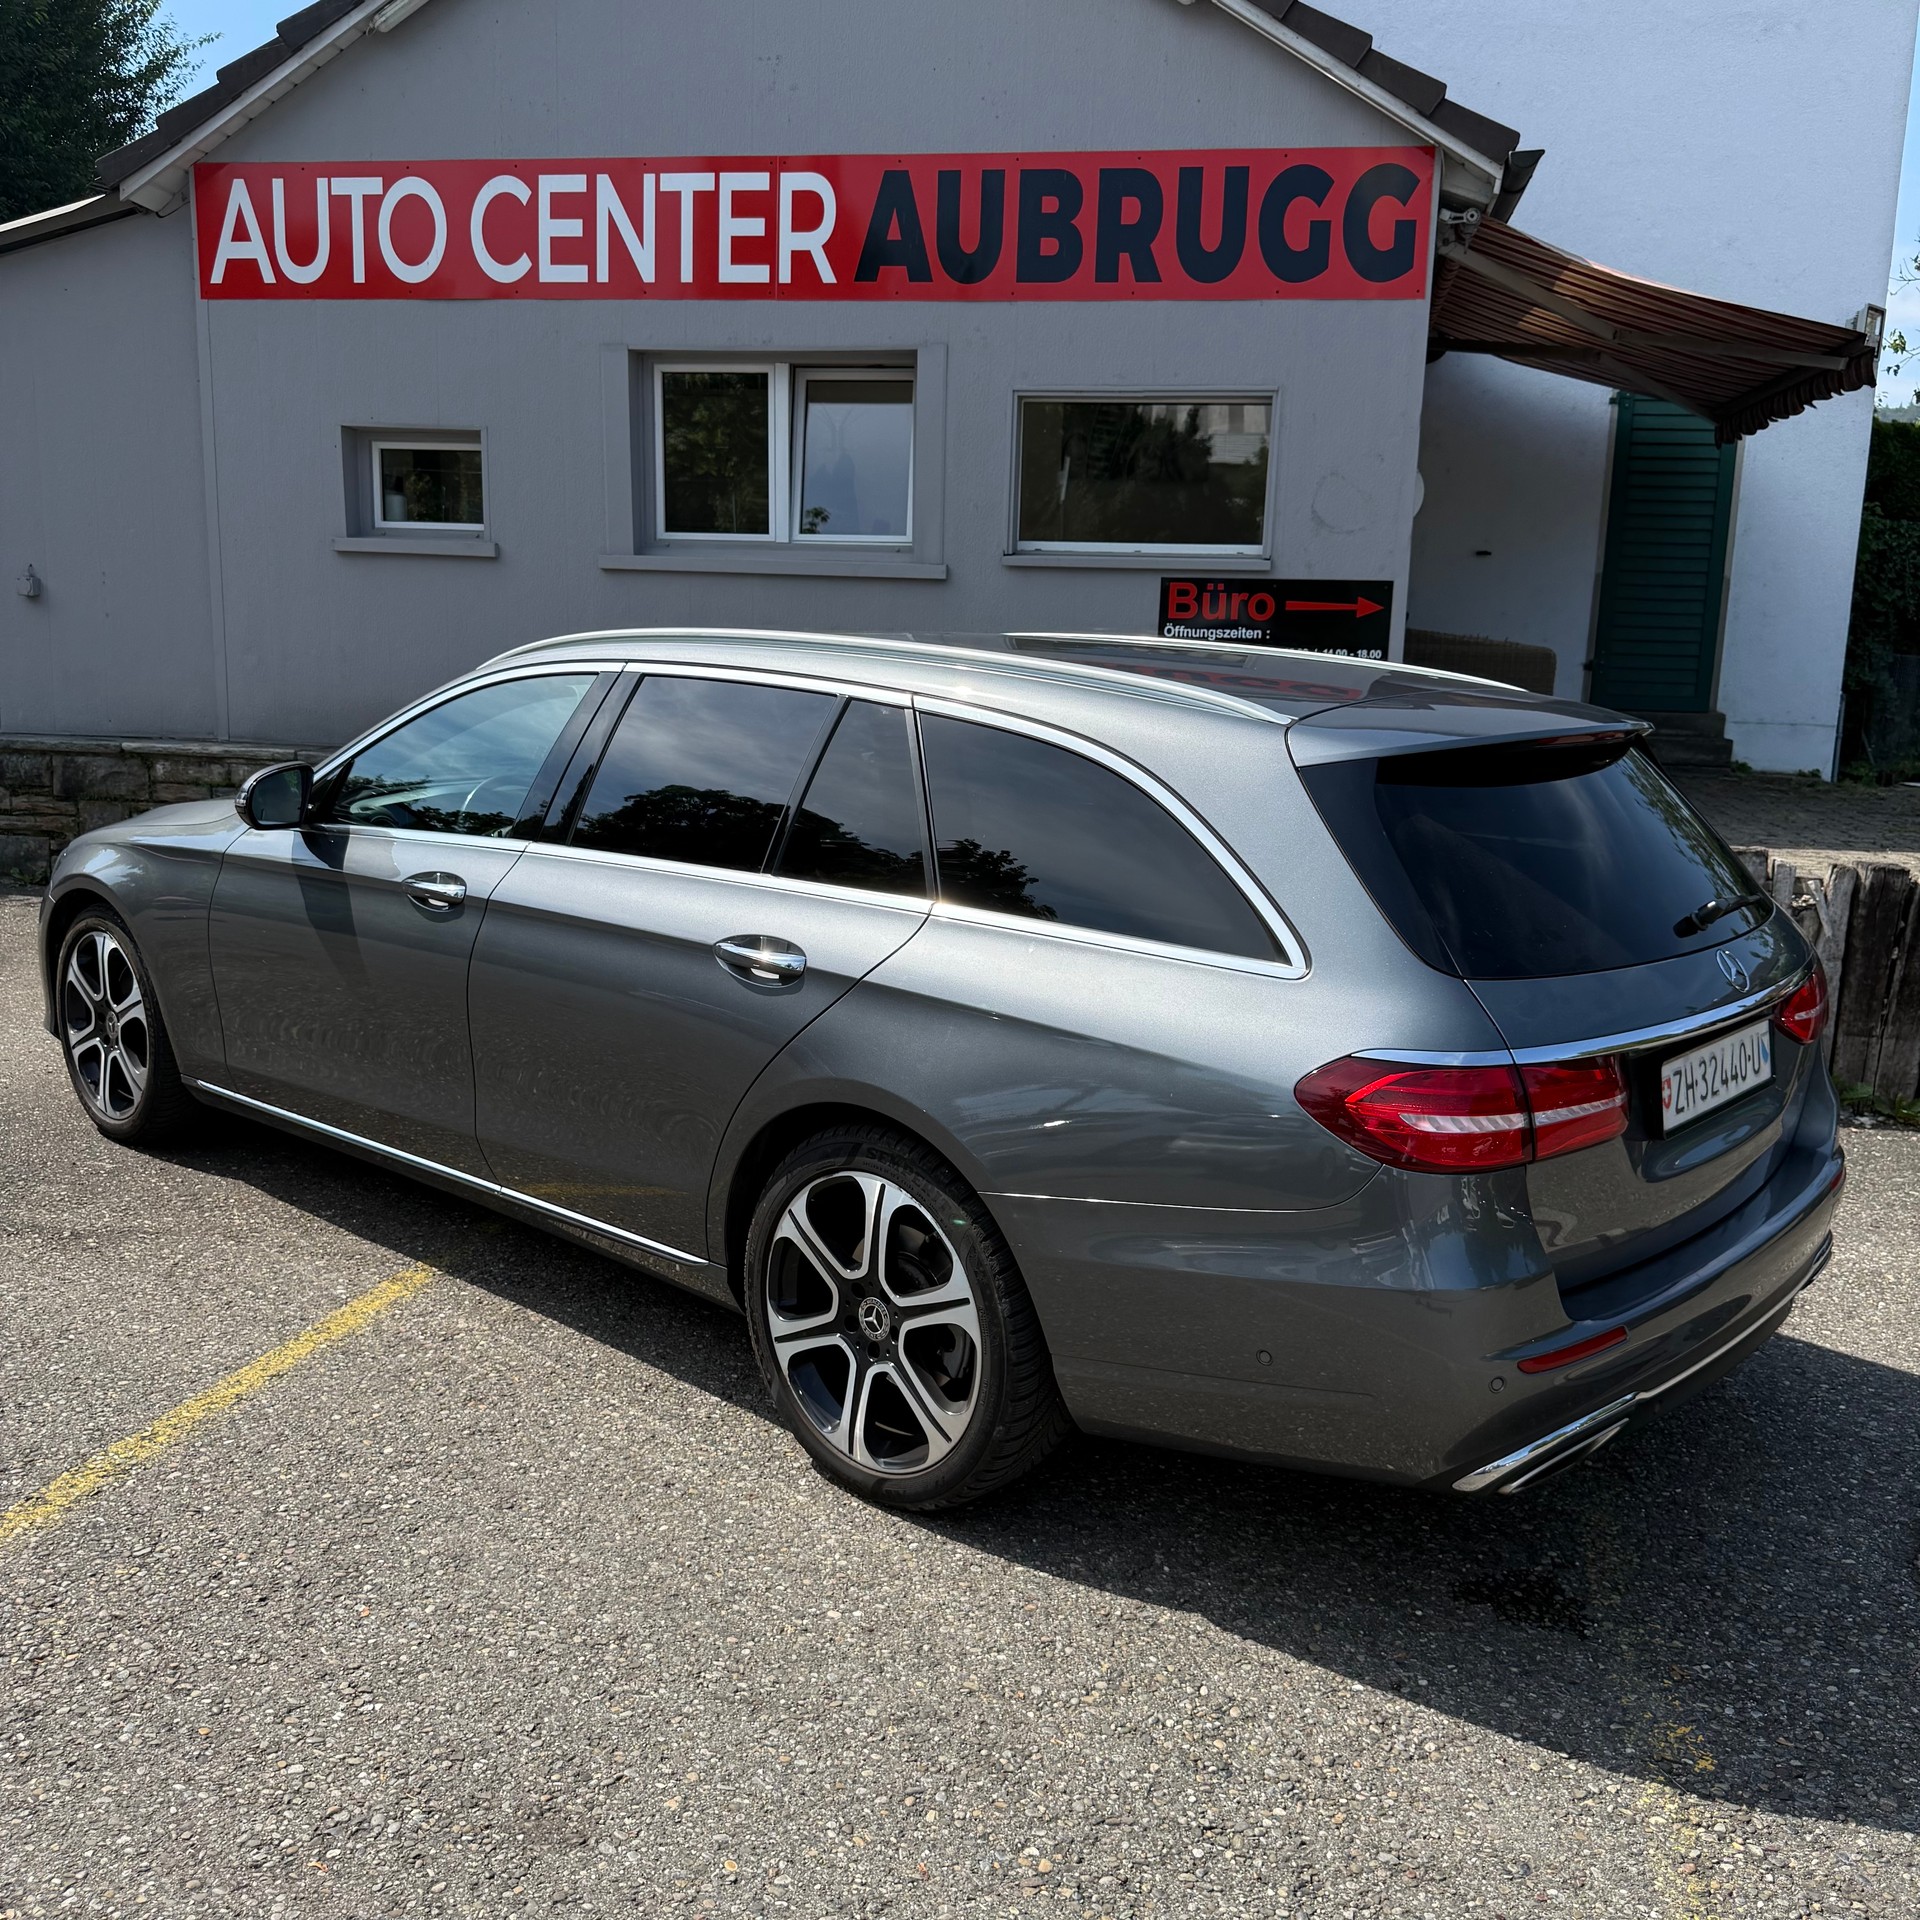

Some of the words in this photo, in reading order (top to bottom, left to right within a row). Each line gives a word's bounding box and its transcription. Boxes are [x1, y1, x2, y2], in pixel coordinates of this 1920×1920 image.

[210, 175, 447, 284] AUTO
[470, 172, 838, 284] CENTER
[853, 162, 1421, 284] AUBRUGG
[1167, 581, 1276, 622] Büro
[1163, 622, 1262, 641] Öffnungszeiten
[1322, 648, 1348, 657] 1400
[1356, 649, 1382, 659] 18.00
